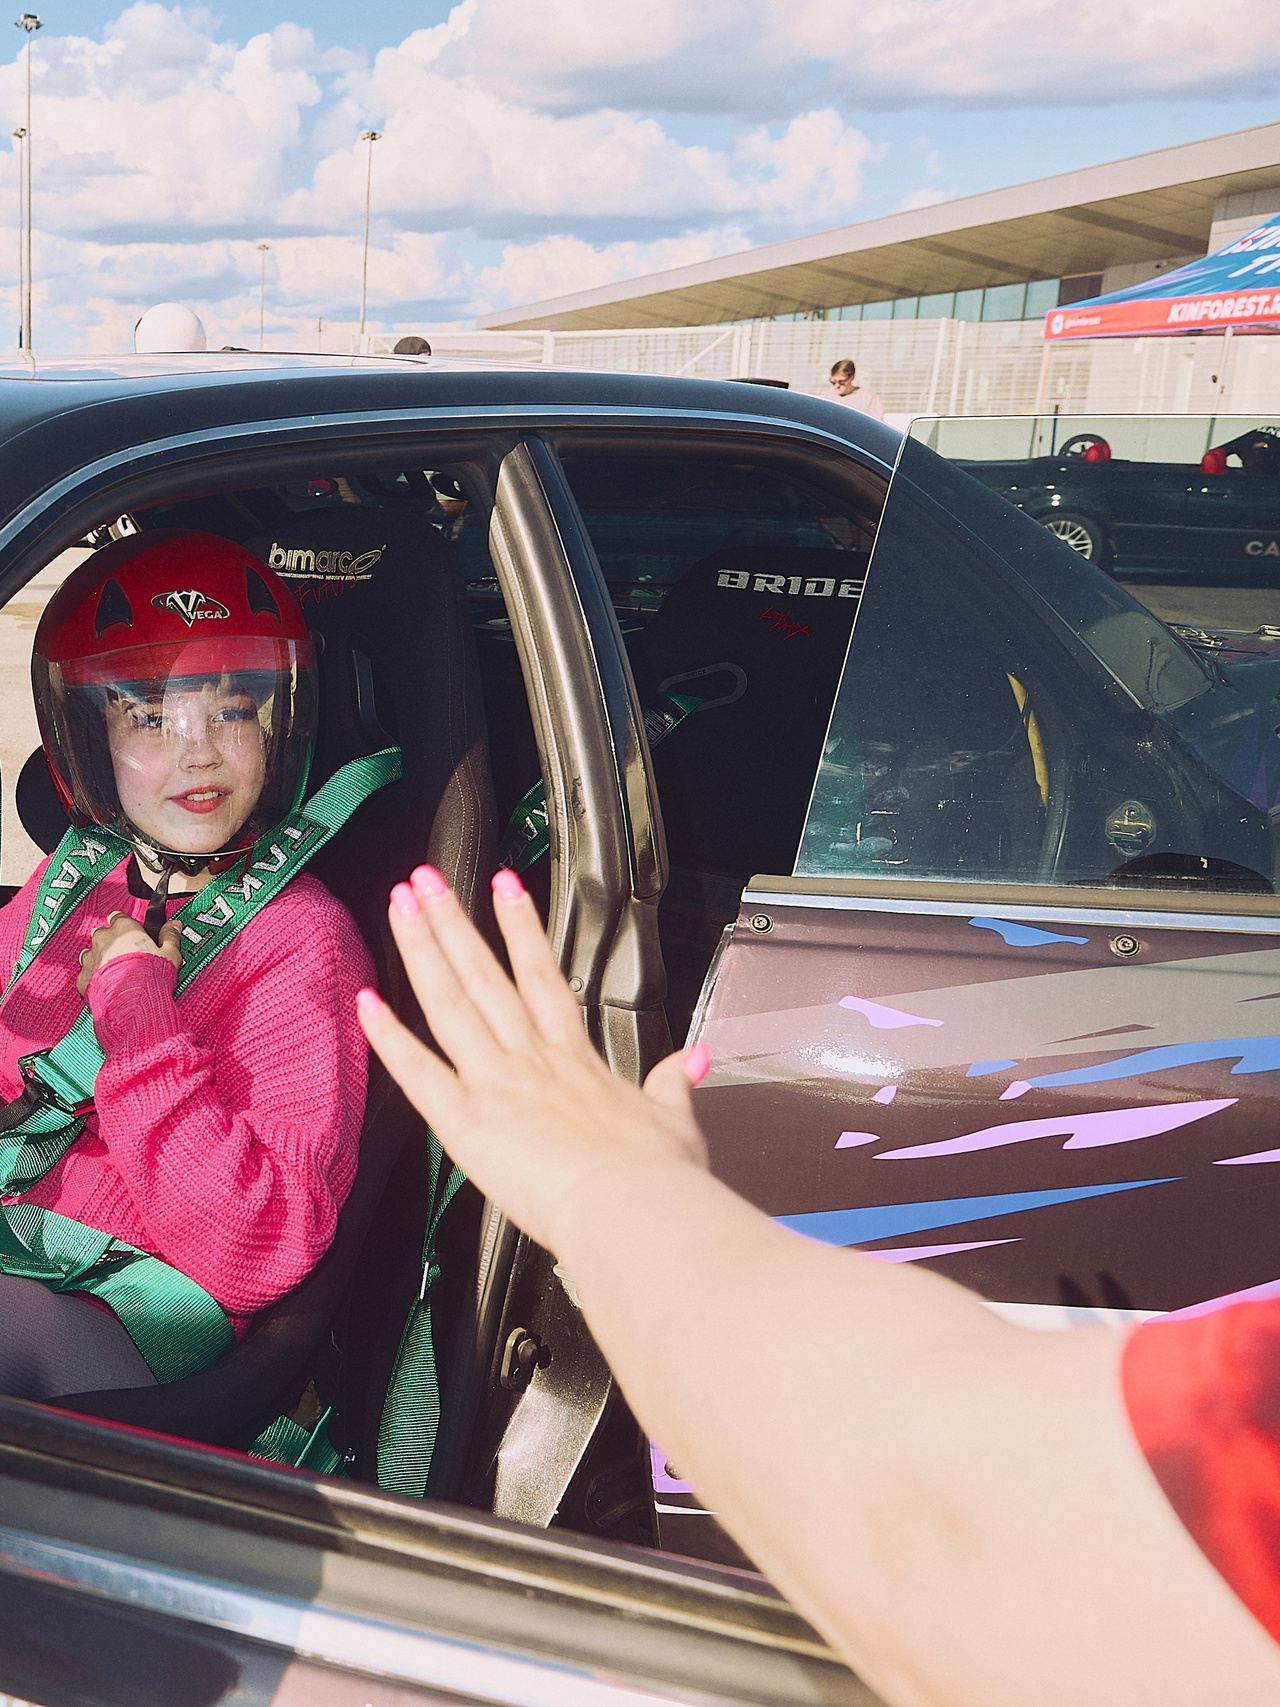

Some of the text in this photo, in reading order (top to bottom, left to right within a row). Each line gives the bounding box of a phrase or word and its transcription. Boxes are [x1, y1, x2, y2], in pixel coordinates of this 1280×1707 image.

[268, 542, 383, 575] bimarco
[716, 568, 865, 599] BRIDE
[188, 610, 223, 620] VEGA
[29, 835, 111, 947] KATA
[181, 824, 317, 957] TAKAT
